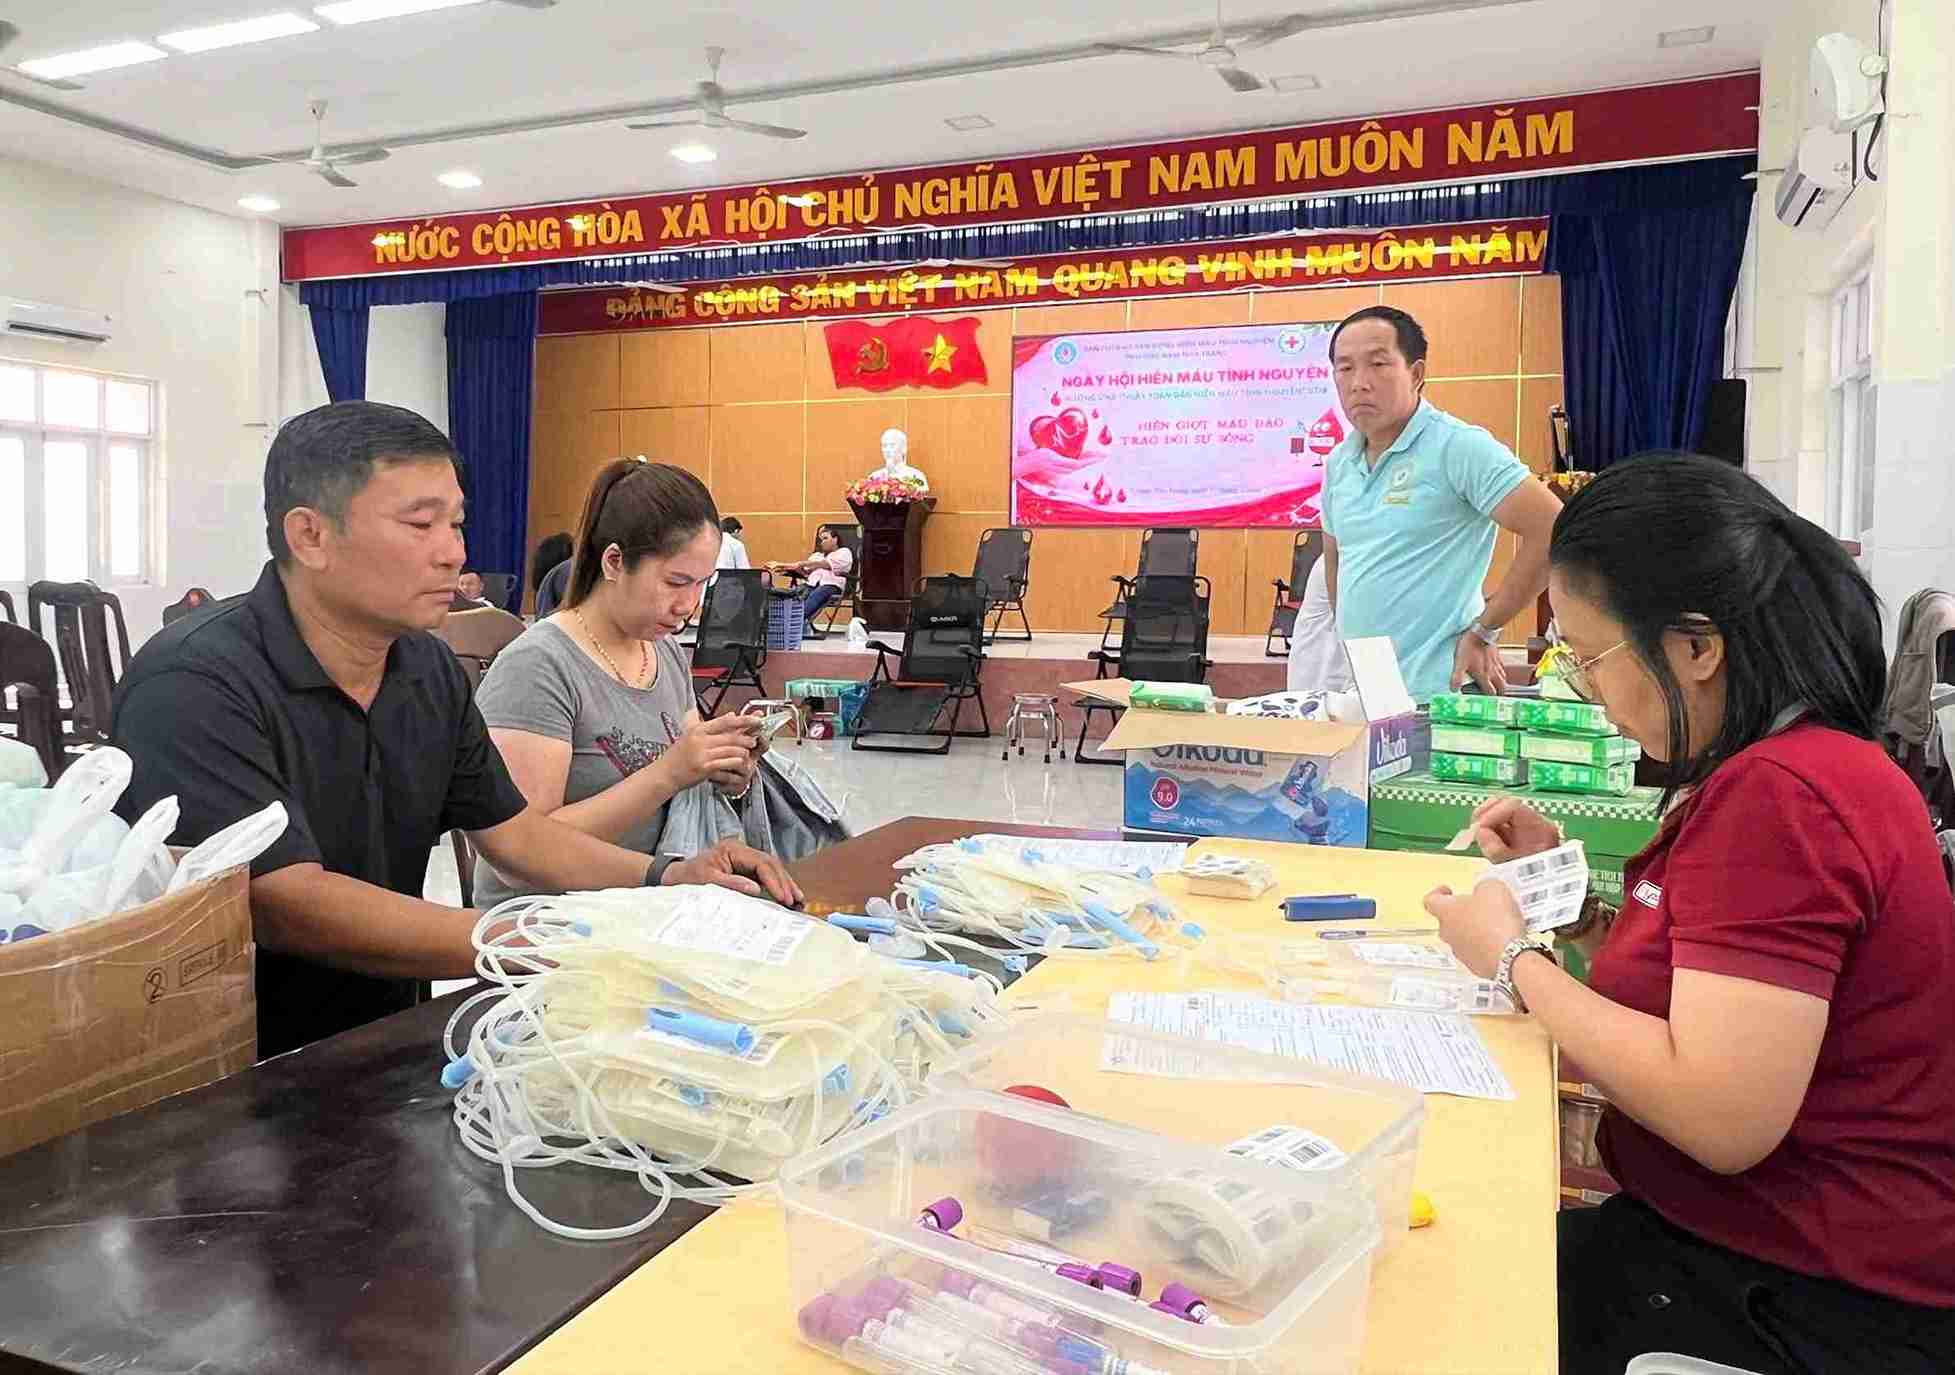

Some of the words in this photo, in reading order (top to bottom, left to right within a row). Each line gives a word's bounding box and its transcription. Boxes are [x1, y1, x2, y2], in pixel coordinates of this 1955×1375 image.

[374, 219, 460, 264] NƯỚC
[472, 213, 561, 262] CỘNG
[573, 202, 644, 248] HÒA
[660, 193, 711, 239] XÃ
[725, 187, 786, 239] HỘI
[801, 174, 879, 227] CHỦ
[894, 163, 1019, 219] NGHĨA
[1032, 153, 1131, 211] VIỆT
[1149, 146, 1256, 195] NAM
[1275, 121, 1424, 182] MUÔN
[1448, 108, 1574, 165] NĂM
[606, 287, 687, 320] ĐẢNG
[694, 283, 781, 321] CỘNG
[790, 272, 856, 311] SẢN
[866, 271, 943, 310] VIỆT
[955, 267, 1037, 301] NAM
[1052, 255, 1186, 298] QUANG
[1198, 248, 1292, 284] VINH
[1305, 231, 1435, 276] MUÔN
[1450, 225, 1547, 266] NĂM
[1109, 370, 1134, 388] HỘI
[1177, 367, 1213, 383] MÁU
[1217, 366, 1255, 381] TÌNH
